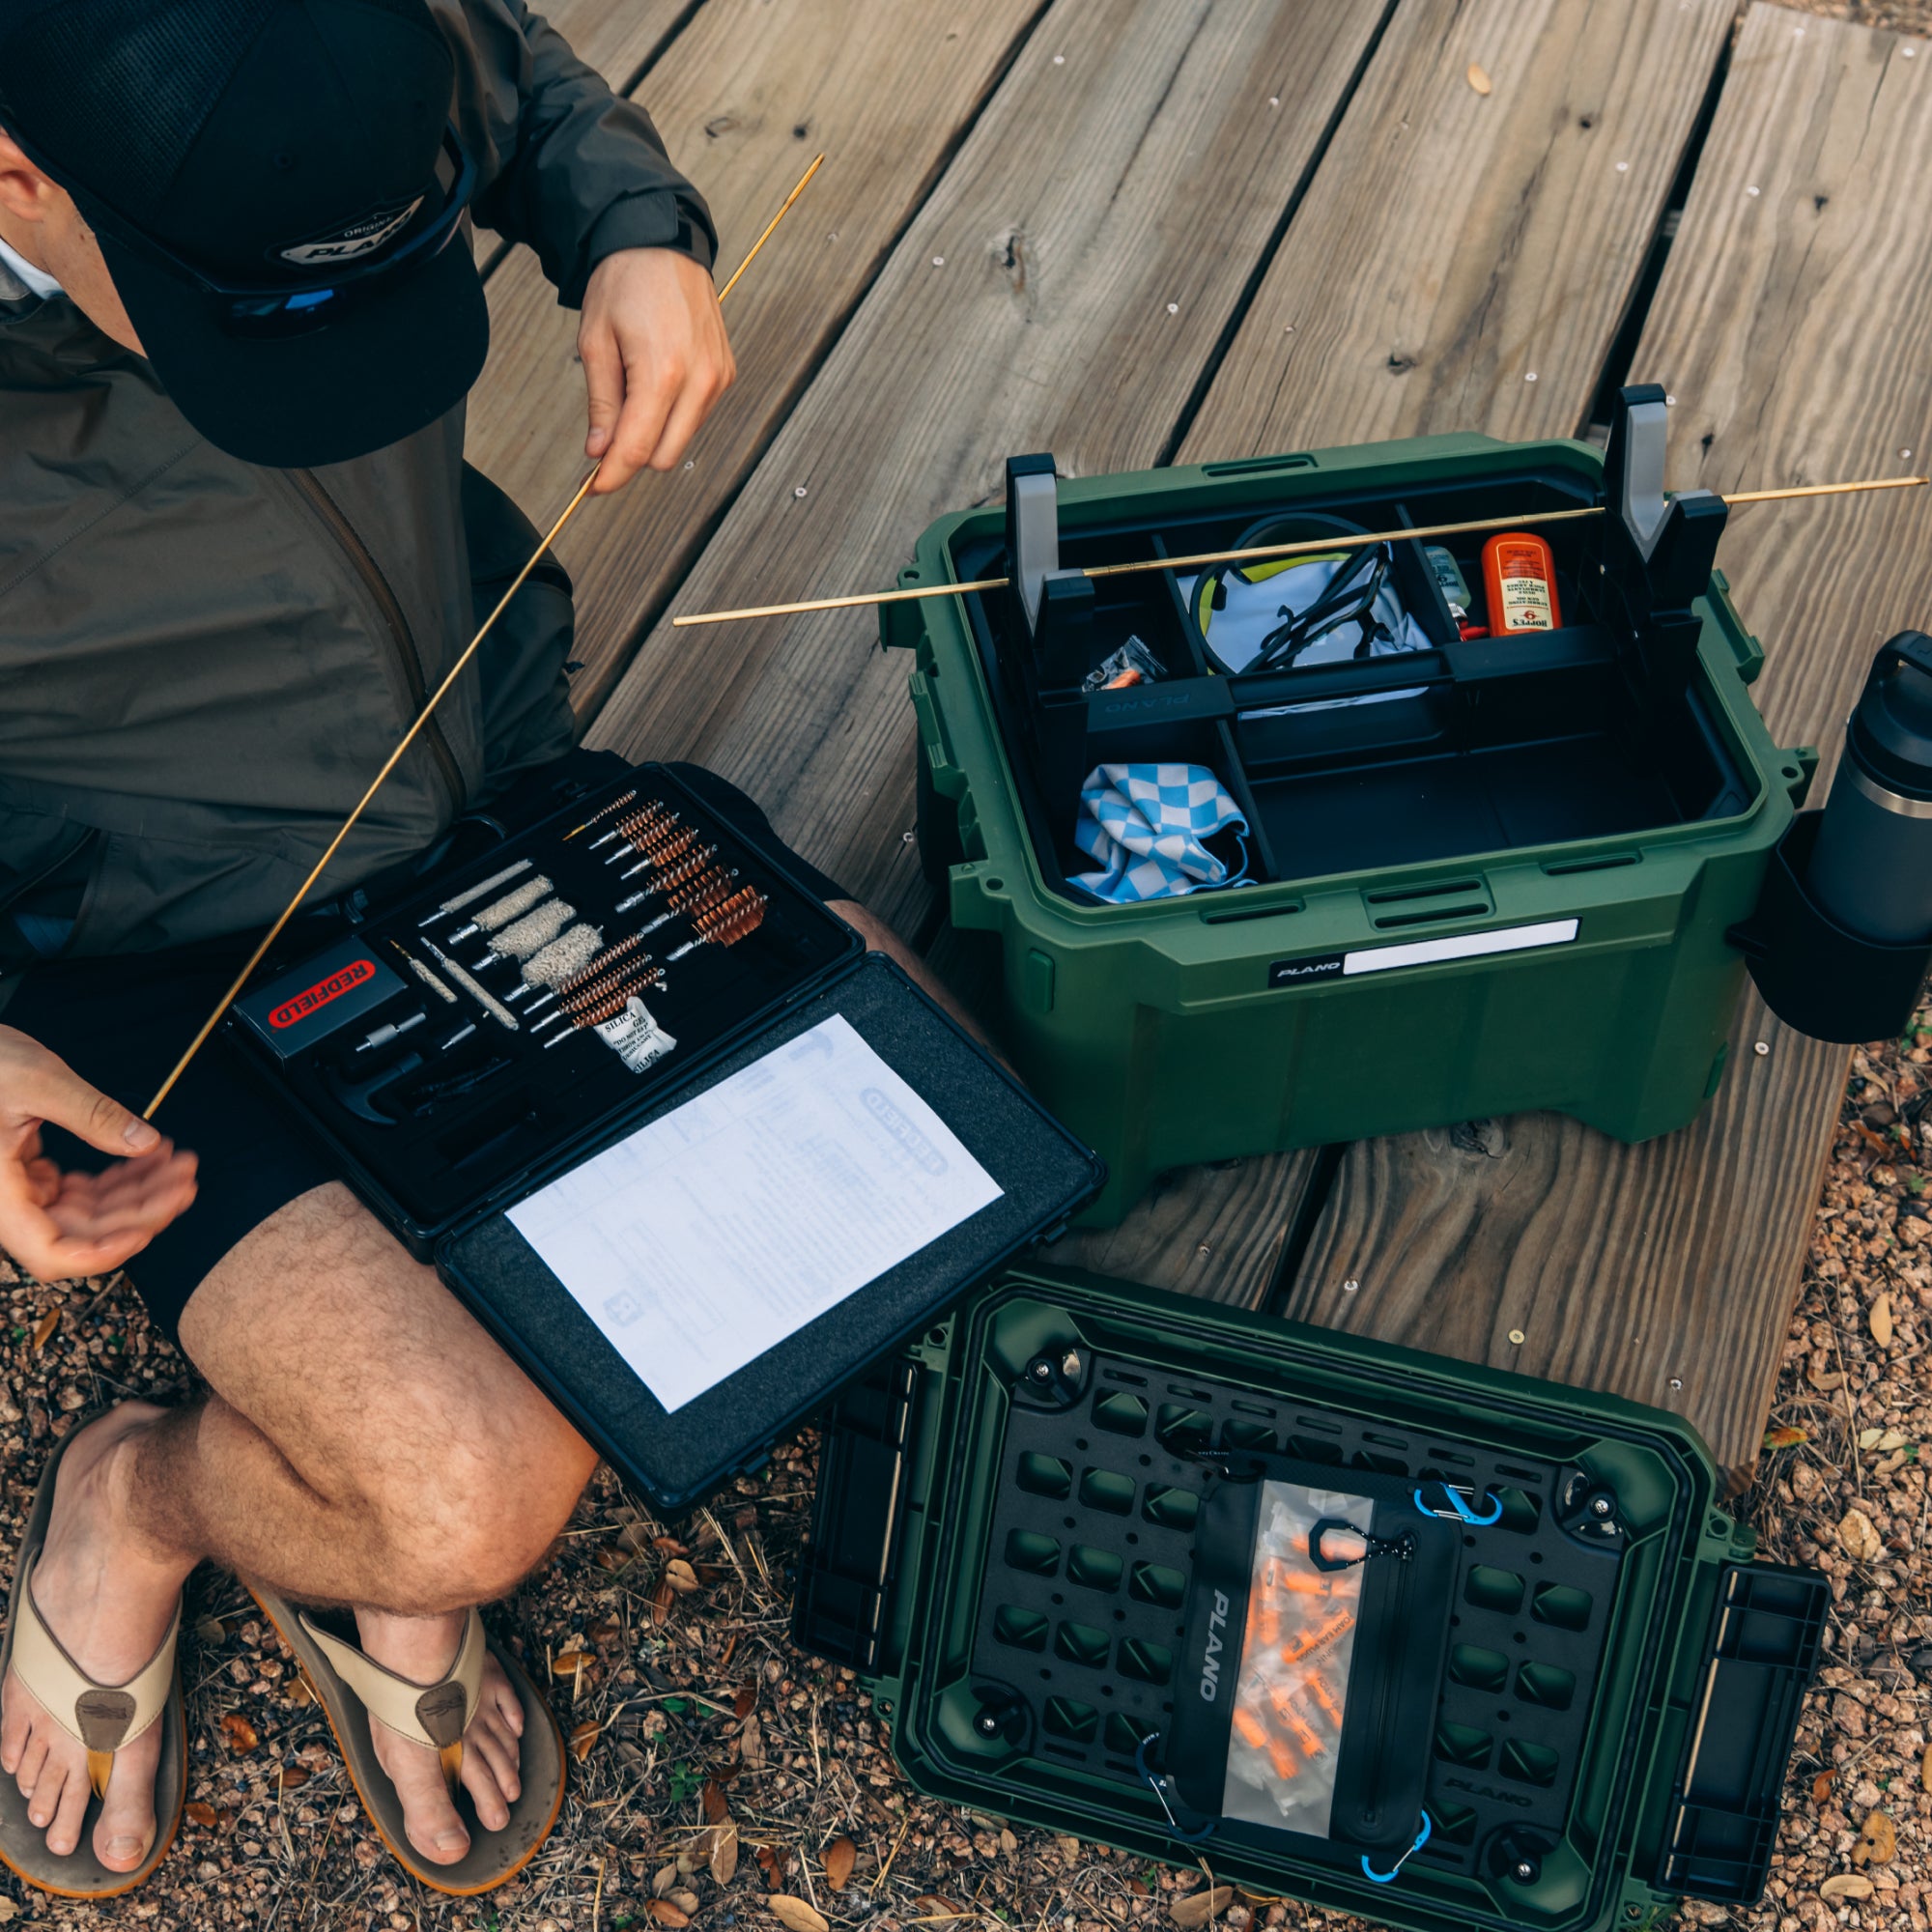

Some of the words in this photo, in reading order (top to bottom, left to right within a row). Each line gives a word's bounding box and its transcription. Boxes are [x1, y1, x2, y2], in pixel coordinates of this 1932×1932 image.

[344, 215, 393, 238] ORIGINA
[1104, 693, 1190, 713] PLANO
[1276, 962, 1341, 978] PLANO
[276, 963, 368, 1023] REDFIELD
[605, 1010, 636, 1033] SILICA
[1200, 1588, 1230, 1702] PLANO
